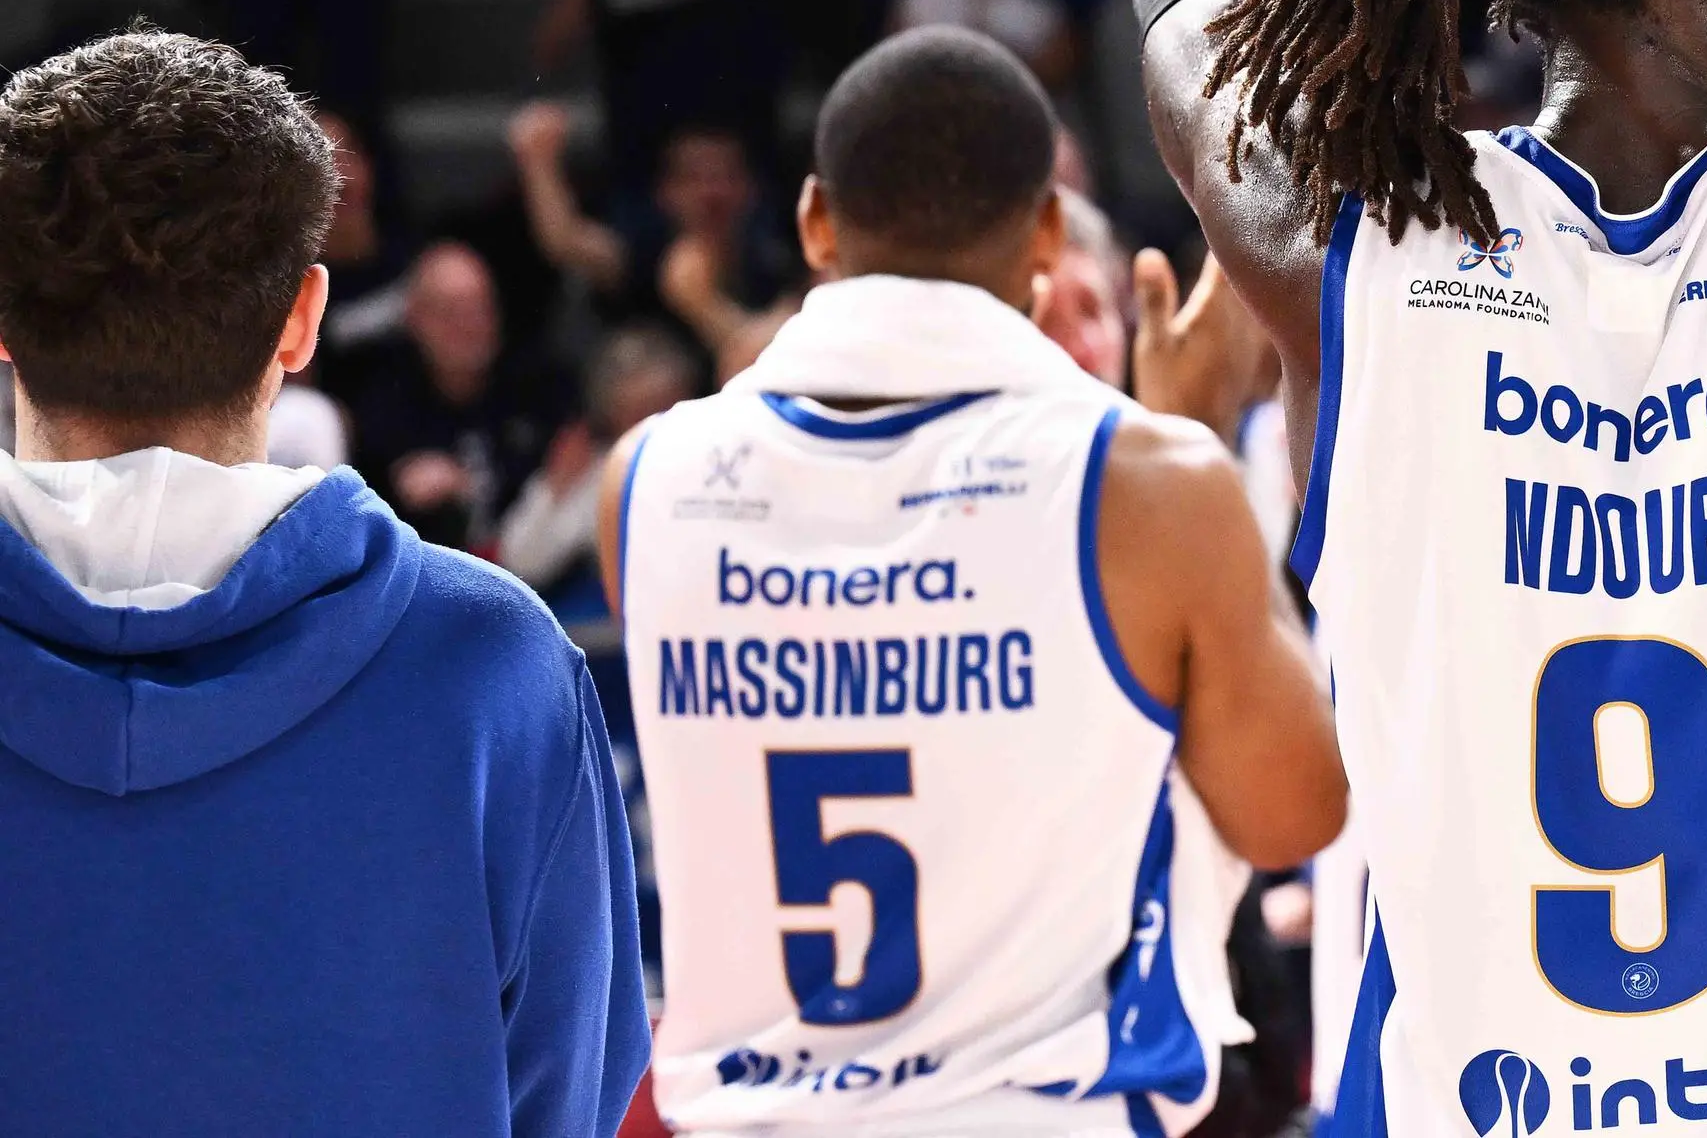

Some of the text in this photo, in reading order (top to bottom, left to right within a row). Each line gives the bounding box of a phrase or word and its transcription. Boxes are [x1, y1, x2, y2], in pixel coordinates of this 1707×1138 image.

[1408, 299, 1549, 325] MELANOMA FOUNDATION
[1410, 279, 1507, 303] CAROLINA
[719, 548, 975, 607] bonera.
[659, 630, 1034, 719] MASSINBURG
[764, 747, 923, 1027] 5
